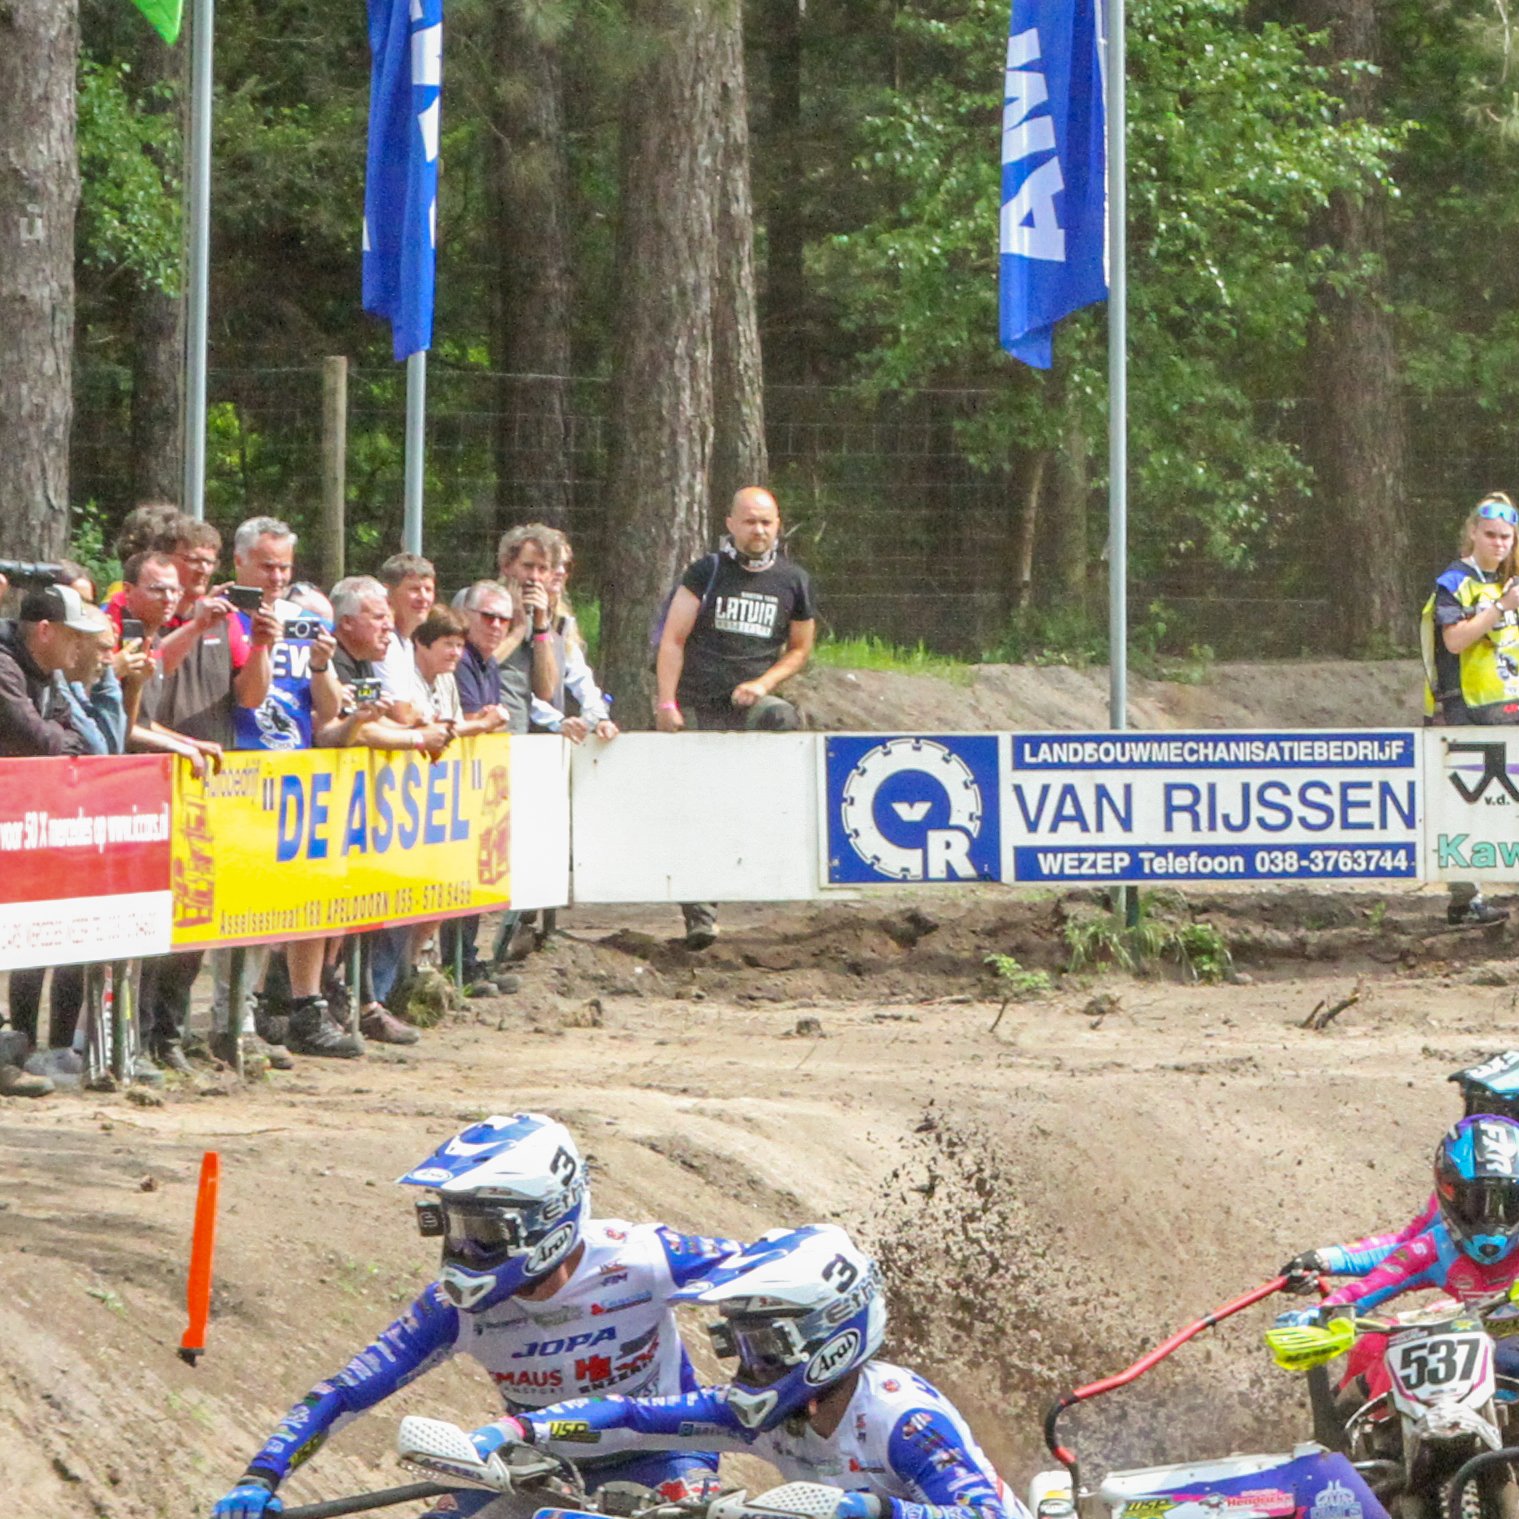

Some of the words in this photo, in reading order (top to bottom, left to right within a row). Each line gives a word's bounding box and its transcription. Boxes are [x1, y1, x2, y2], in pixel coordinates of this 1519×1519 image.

[1012, 782, 1134, 834] VAN
[1164, 779, 1419, 832] RIJSSEN
[1037, 852, 1131, 876] WEZEP
[1141, 850, 1245, 875] Telefoon
[1254, 849, 1409, 874] 038-3763744
[327, 892, 389, 924] APELDOORN
[549, 1144, 578, 1188] 3
[821, 1253, 859, 1294] 3
[511, 1325, 617, 1359] JOPA
[816, 1333, 854, 1375] Arai
[1400, 1338, 1481, 1391] 537
